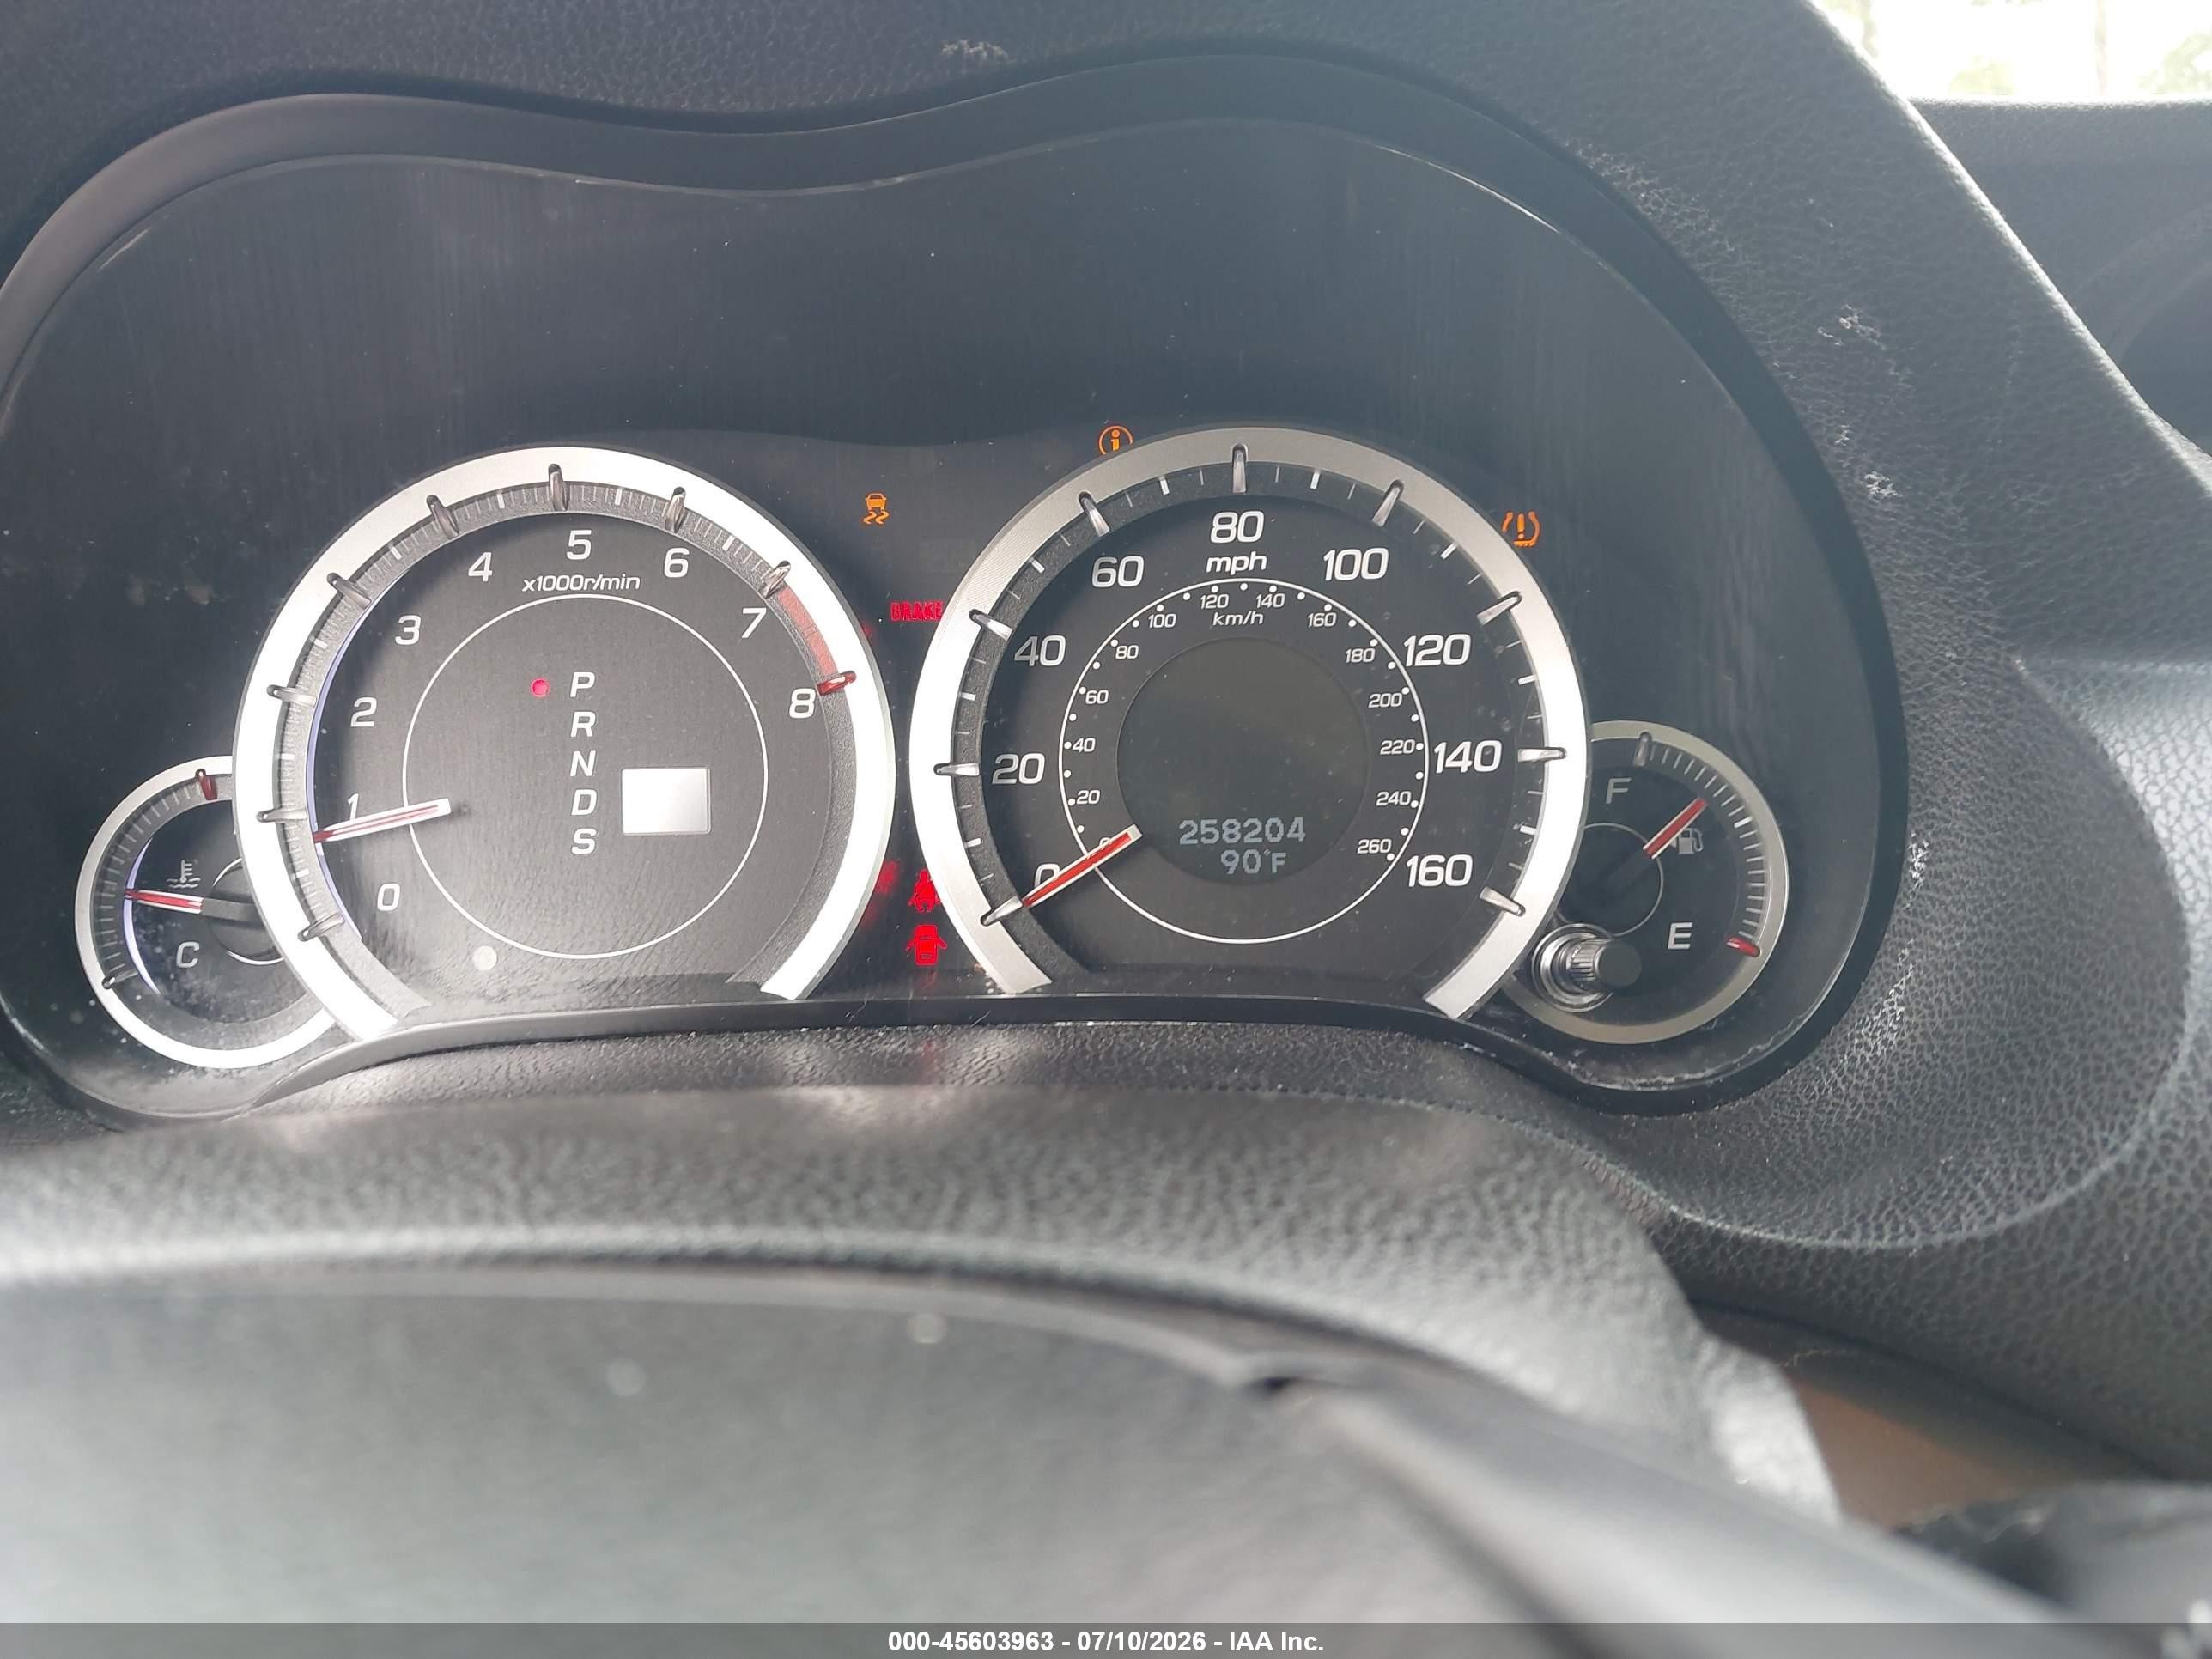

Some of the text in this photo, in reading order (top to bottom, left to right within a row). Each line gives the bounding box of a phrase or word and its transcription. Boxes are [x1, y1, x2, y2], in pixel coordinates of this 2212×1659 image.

[1211, 512, 1265, 542] 80
[566, 530, 592, 558] 5
[469, 552, 493, 580] 4
[665, 548, 689, 577] 6
[1091, 556, 1144, 586] 60
[1206, 553, 1267, 574] mph
[1323, 549, 1389, 580] 100
[522, 574, 640, 592] x1000r/min
[890, 600, 944, 621] BRAKE
[1200, 593, 1228, 608] 120
[1255, 593, 1285, 608] 140
[395, 616, 421, 644] 3
[741, 609, 766, 638] 7
[1148, 613, 1176, 628] 100
[1212, 611, 1263, 626] km/h
[1307, 612, 1336, 628] 160
[1014, 635, 1066, 665] 40
[1115, 644, 1138, 659] 80
[1346, 648, 1375, 663] 180
[1403, 635, 1471, 665] 120
[570, 672, 595, 697] P
[1085, 690, 1108, 704] 60
[351, 698, 377, 726] 2
[789, 690, 815, 718] 8
[1368, 692, 1402, 708] 200
[571, 712, 595, 737] R
[1073, 738, 1096, 752] 40
[1380, 739, 1415, 755] 220
[1434, 741, 1502, 772] 140
[570, 751, 595, 776] N
[992, 754, 1044, 784] 20
[571, 791, 596, 815] D
[1077, 789, 1100, 805] 20
[1376, 791, 1411, 805] 240
[1606, 778, 1631, 804] F
[348, 793, 359, 819] 1
[572, 829, 596, 854] S
[1180, 817, 1305, 844] 258204
[1358, 839, 1391, 854] 260
[1407, 855, 1473, 886] 160
[377, 883, 400, 911] 0
[1668, 922, 1692, 949] E
[176, 941, 199, 968] C
